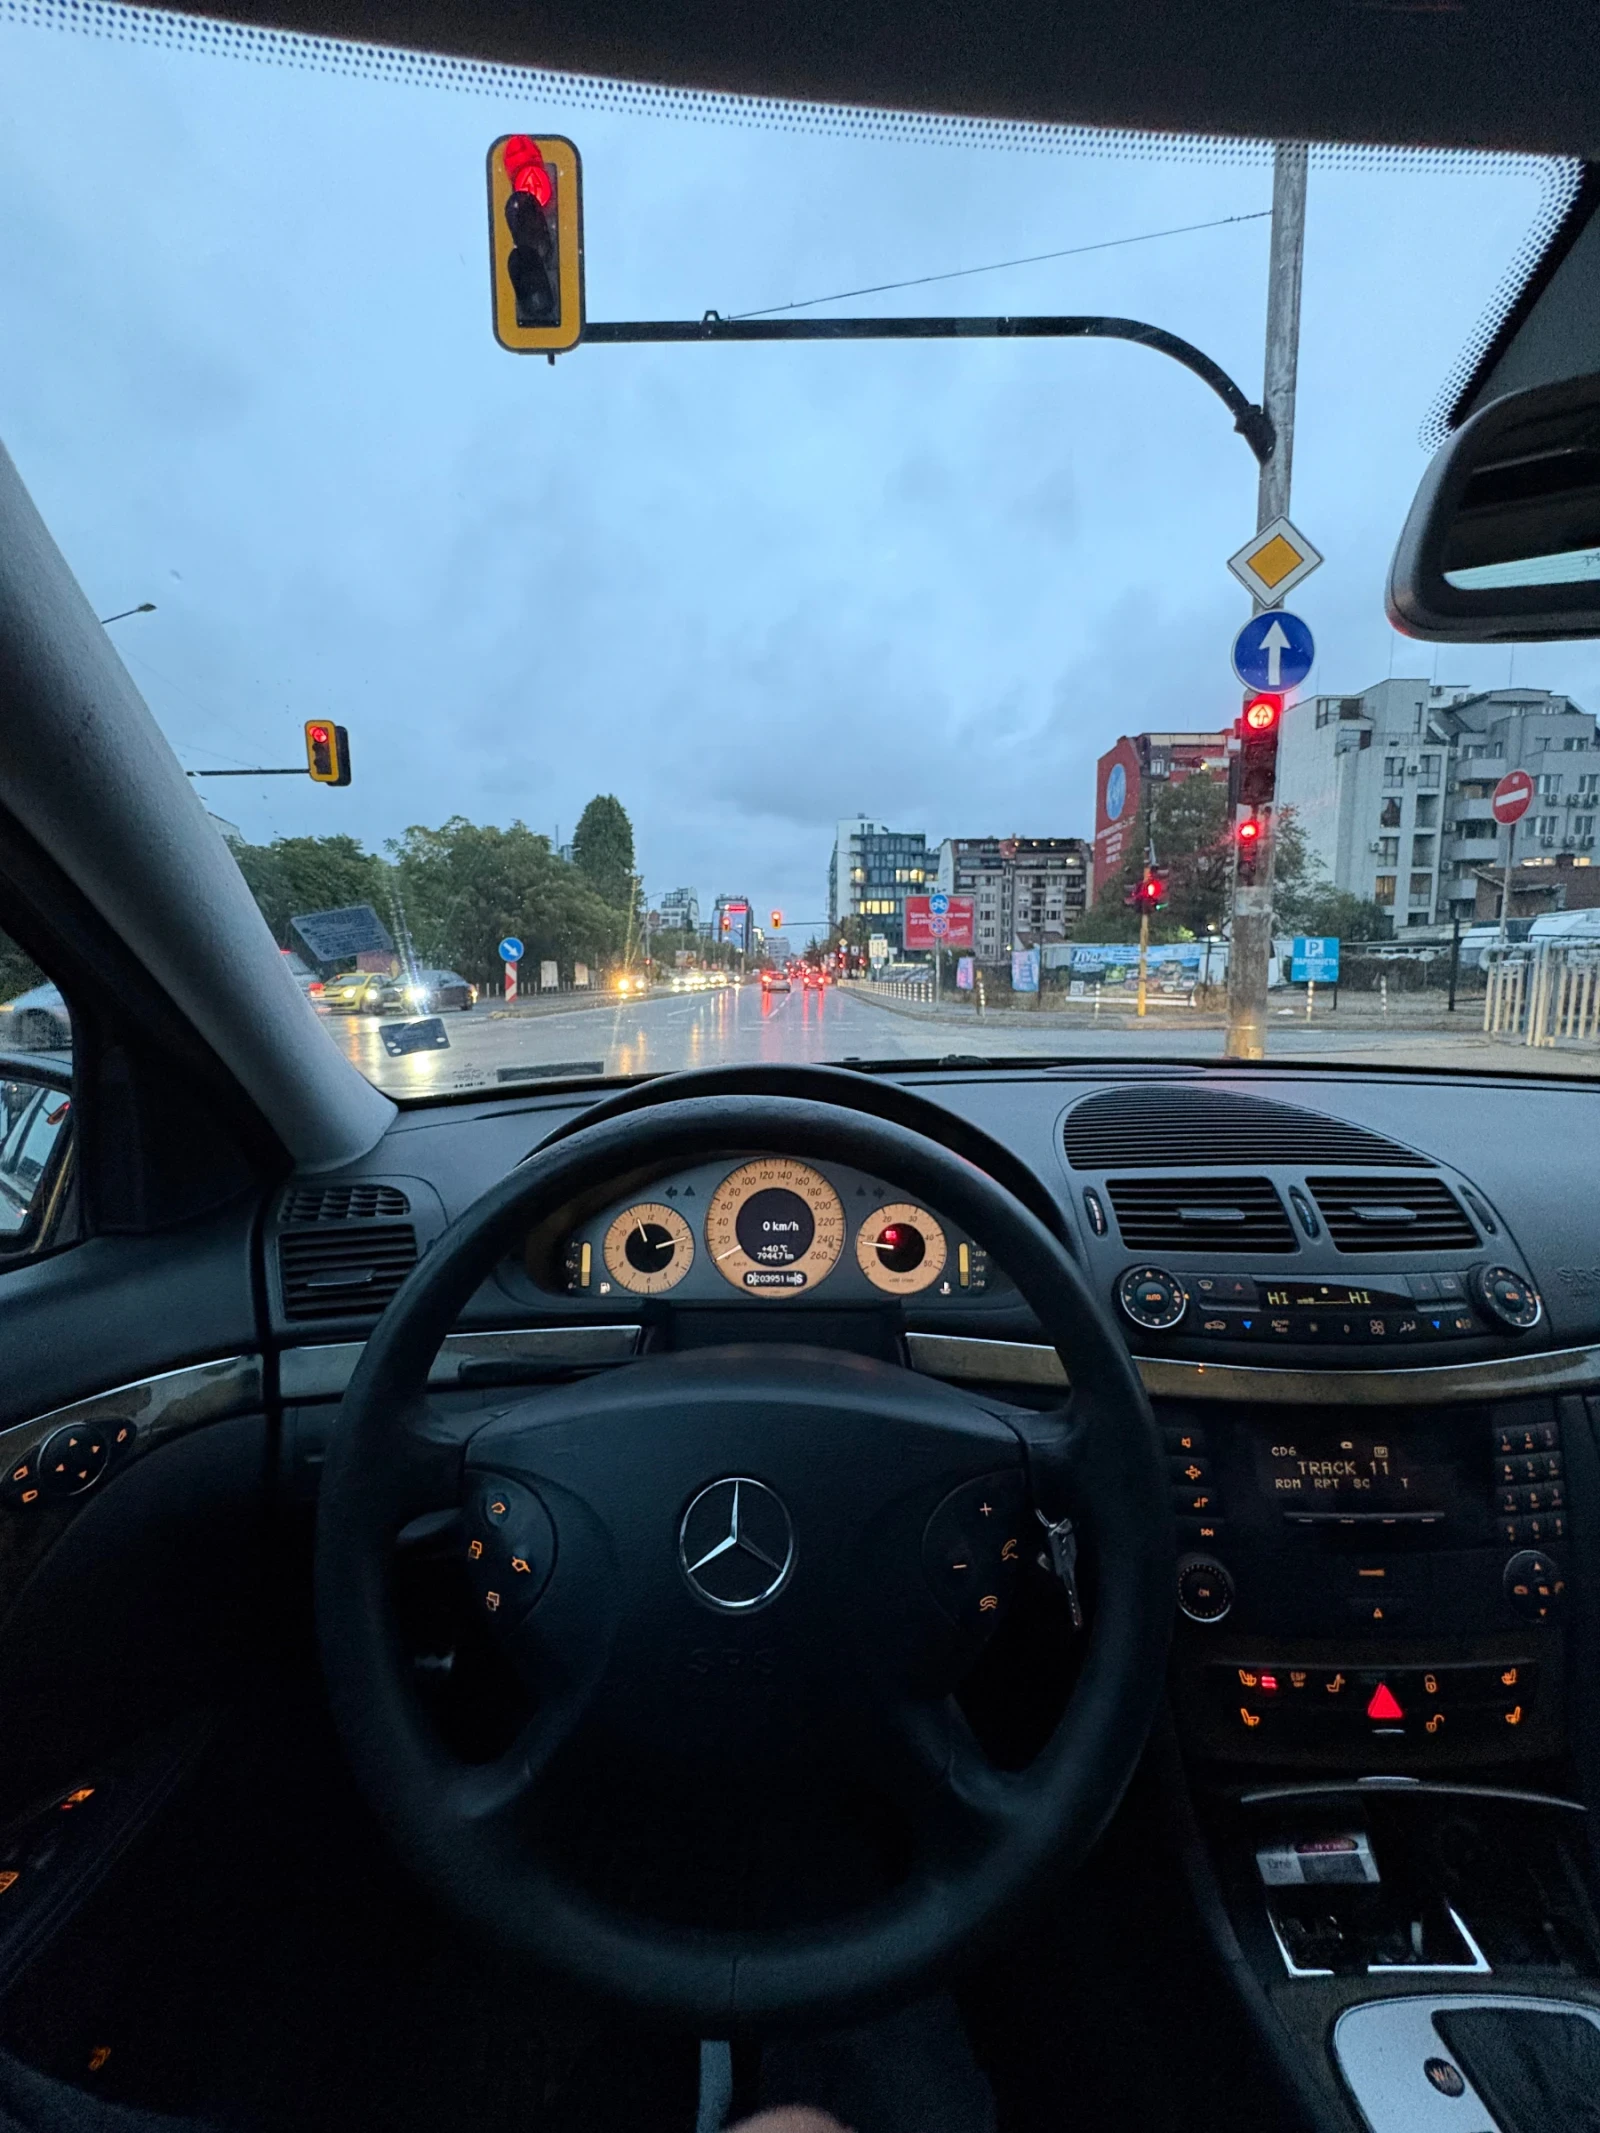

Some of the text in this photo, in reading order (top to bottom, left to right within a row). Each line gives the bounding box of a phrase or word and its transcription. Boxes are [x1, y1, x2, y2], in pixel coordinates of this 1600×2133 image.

[1309, 941, 1319, 955] P
[760, 1171, 774, 1180] 120
[777, 1171, 792, 1180] 140
[741, 1177, 756, 1186] 100
[795, 1177, 810, 1186] 160
[729, 1187, 741, 1197] 80
[807, 1187, 821, 1197] 180
[720, 1201, 733, 1211] 60
[814, 1201, 831, 1211] 200
[716, 1217, 729, 1227] 40
[762, 1221, 799, 1232] 0 km/h
[817, 1217, 835, 1227] 220
[718, 1235, 731, 1244] 20
[817, 1235, 835, 1244] 240
[810, 1251, 828, 1260] 260
[1267, 1291, 1289, 1305] HI
[1349, 1291, 1371, 1304] HI
[1271, 1446, 1297, 1456] CD6
[1297, 1461, 1389, 1475] TRACK 11
[1275, 1479, 1302, 1489] RDM
[1314, 1479, 1340, 1489] RPT
[1353, 1479, 1370, 1489] SC
